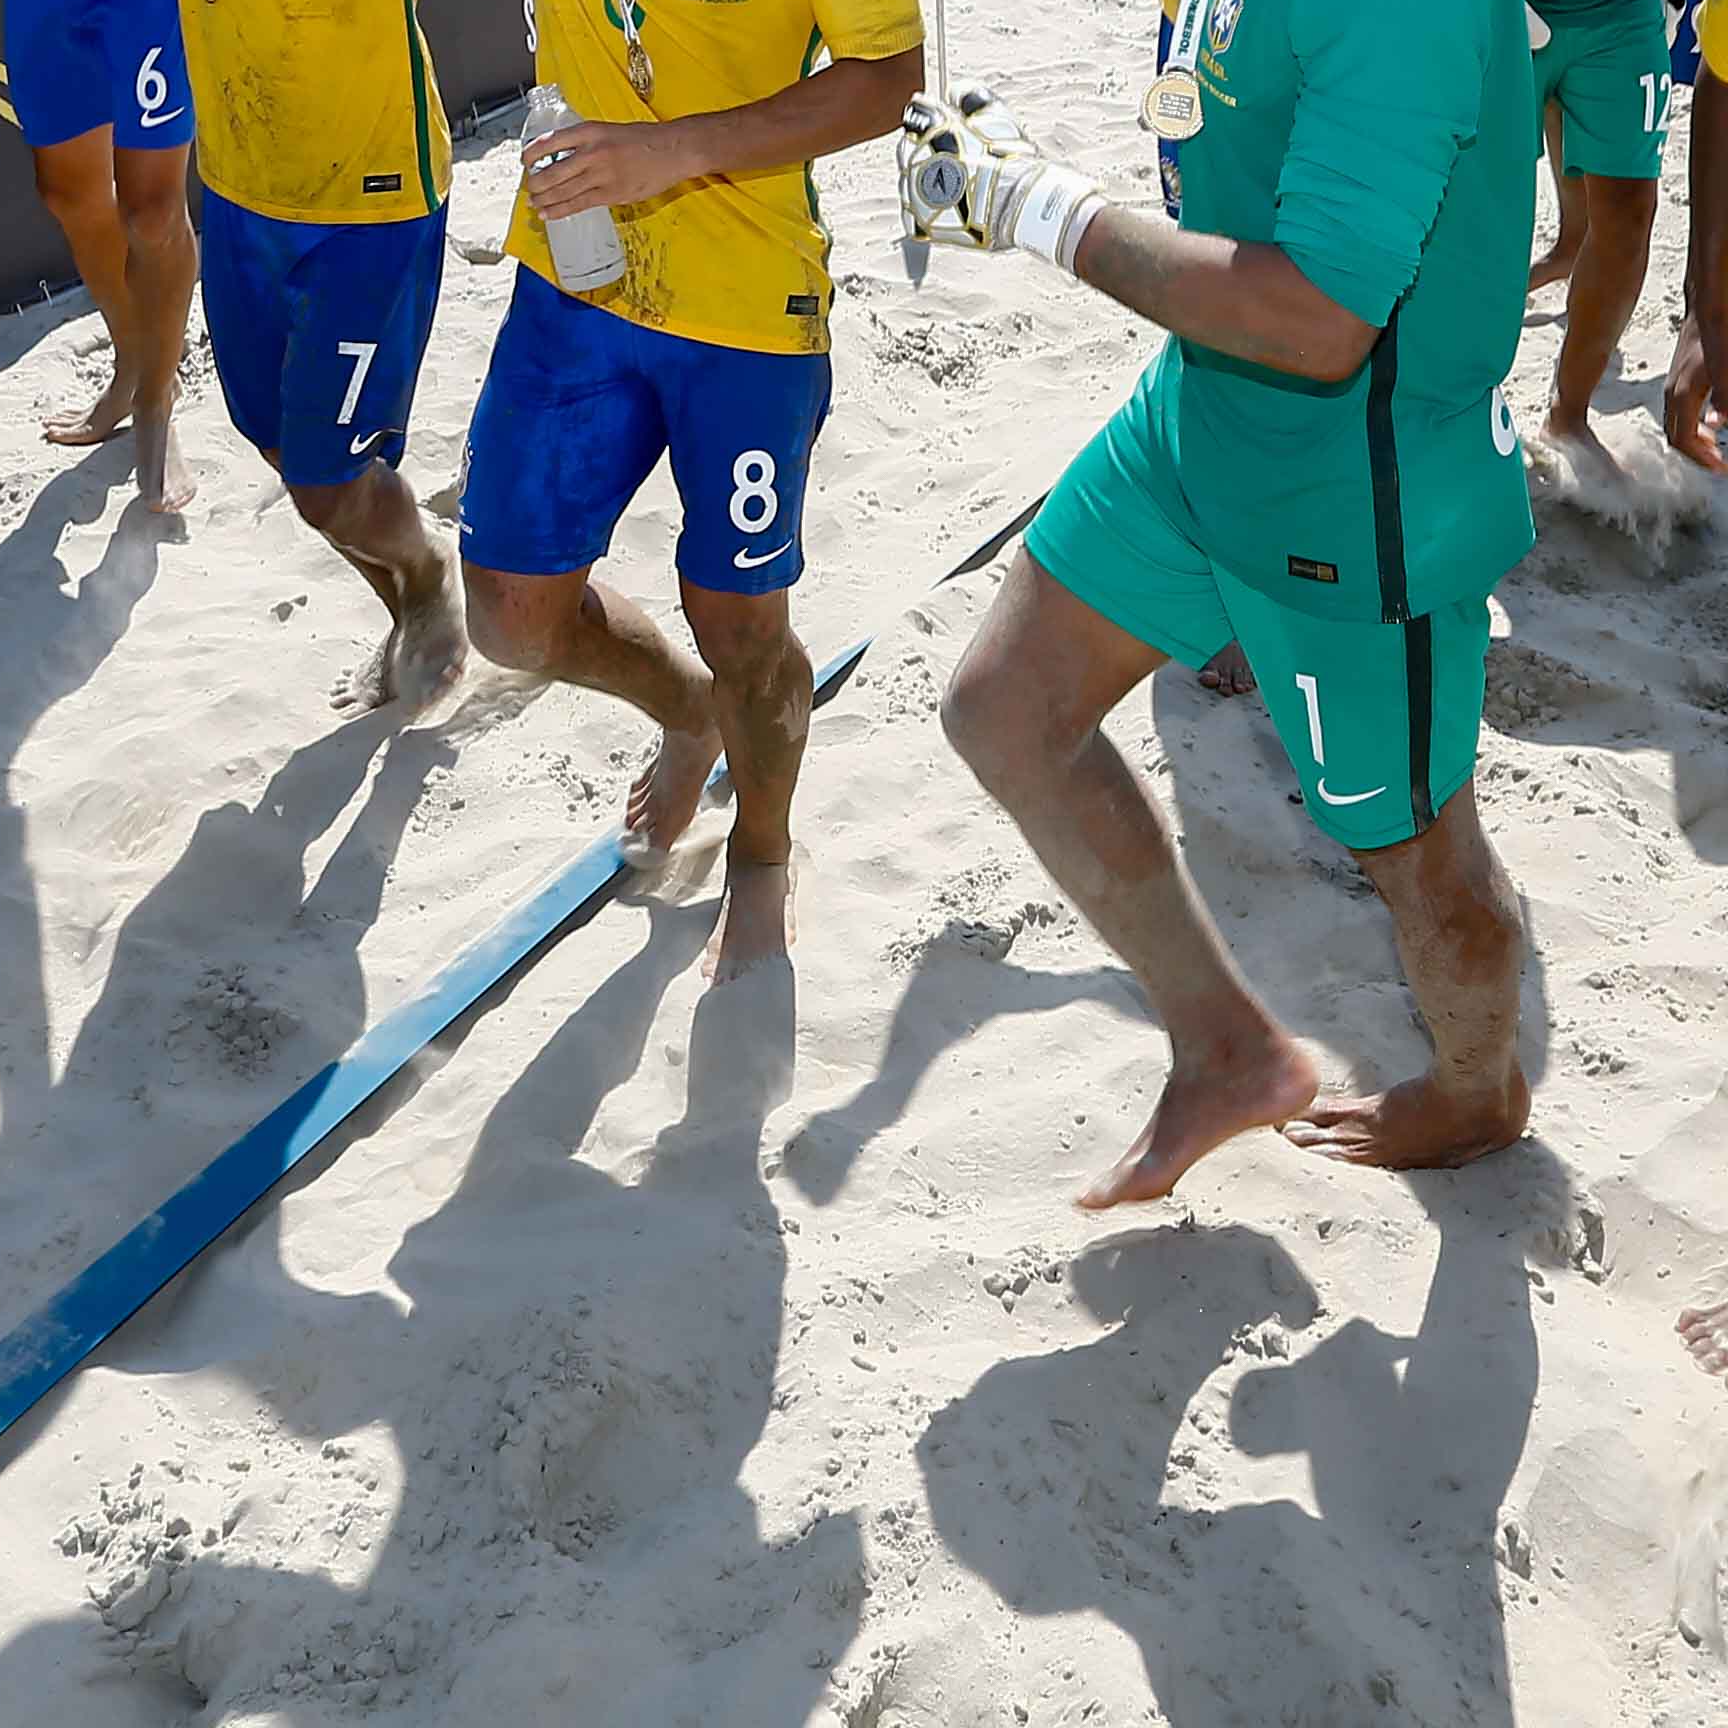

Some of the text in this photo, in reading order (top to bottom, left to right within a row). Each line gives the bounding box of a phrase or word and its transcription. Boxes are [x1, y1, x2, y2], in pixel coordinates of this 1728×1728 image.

[136, 47, 167, 111] 6
[1639, 72, 1671, 132] 12
[337, 341, 379, 426] 7
[730, 449, 778, 534] 8
[1295, 673, 1325, 765] 1
